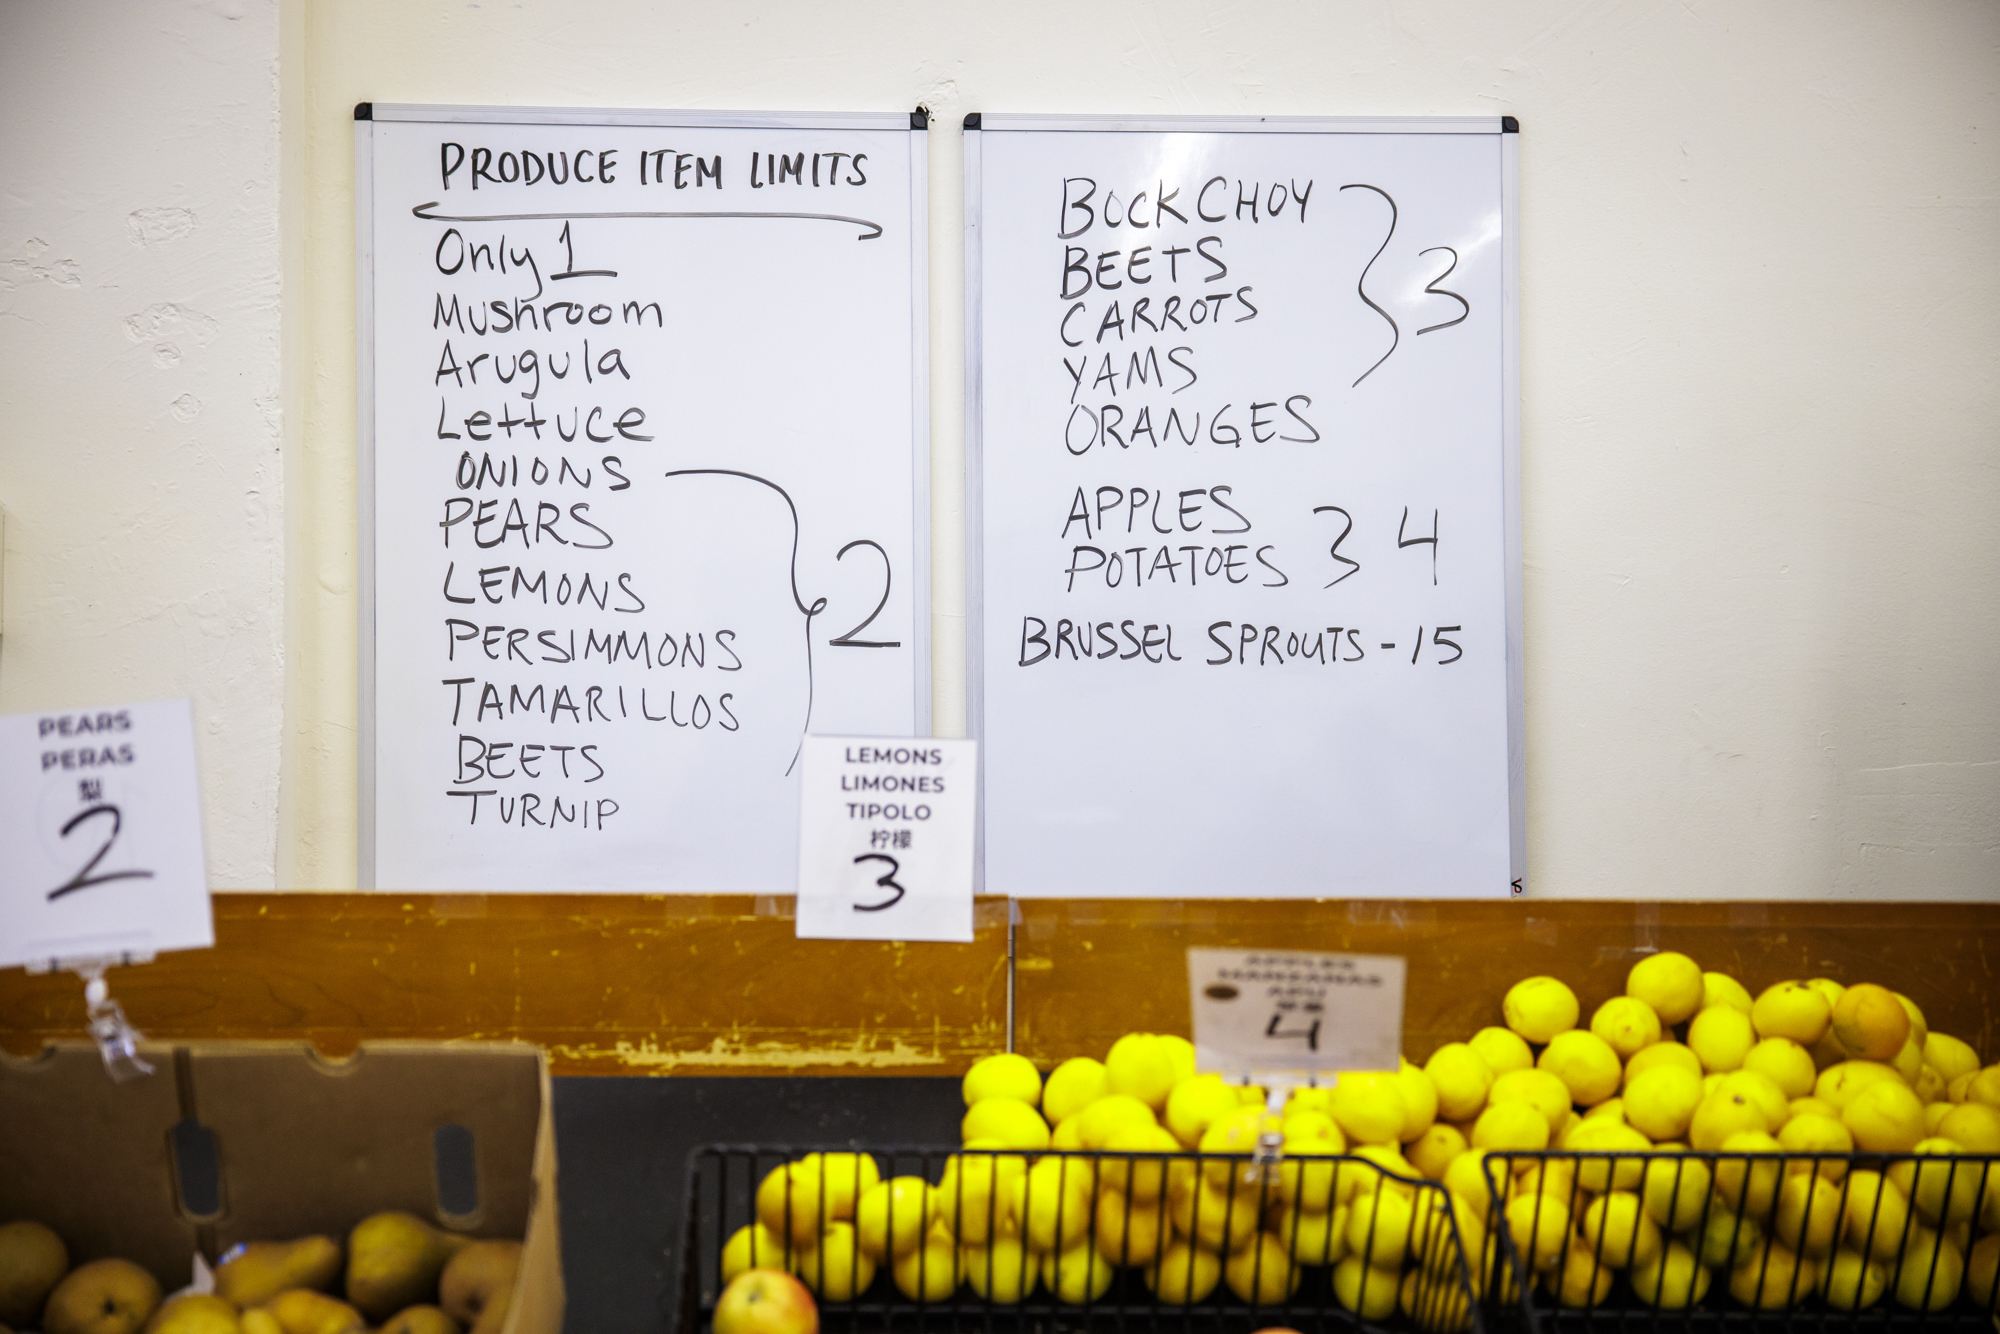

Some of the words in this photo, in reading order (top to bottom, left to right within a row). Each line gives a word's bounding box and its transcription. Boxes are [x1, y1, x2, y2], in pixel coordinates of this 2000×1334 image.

[441, 142, 618, 191] PRODUCE
[640, 149, 722, 189] ITEM
[751, 152, 868, 189] LIMITS
[1197, 176, 1313, 224] CHOY
[436, 228, 543, 304] Only
[1060, 236, 1227, 299] BEETS
[1417, 247, 1470, 336] 3
[433, 293, 662, 334] Mushroom
[1060, 286, 1258, 347] CARROTS
[435, 339, 630, 399] Arugula
[1063, 346, 1197, 404] YAMS
[437, 394, 654, 443] Lettuce
[1065, 395, 1320, 456] ORANGES
[456, 451, 631, 491] ONIONS
[439, 497, 613, 549] PEARS
[1061, 485, 1251, 540] APPLES
[1065, 545, 1288, 593] POTATOES
[1398, 506, 1438, 586] 4
[443, 561, 645, 613] LEMONS
[829, 540, 901, 648] 2
[445, 618, 742, 671] PERSIMMONS
[1018, 616, 1182, 667] BRUSSEL
[1206, 621, 1364, 666] SPROUTS
[38, 711, 131, 738] PEARS
[442, 677, 739, 731] TAMARILLOS
[41, 744, 135, 771] PERAS
[453, 734, 604, 784] BEETS
[846, 747, 942, 765] LEMONS
[841, 775, 945, 793] LIMONES
[446, 790, 619, 831] TURNIP
[846, 803, 931, 820] TIPOLO
[47, 804, 154, 902] 2
[853, 854, 905, 911] 3
[1265, 1014, 1321, 1051] 4
